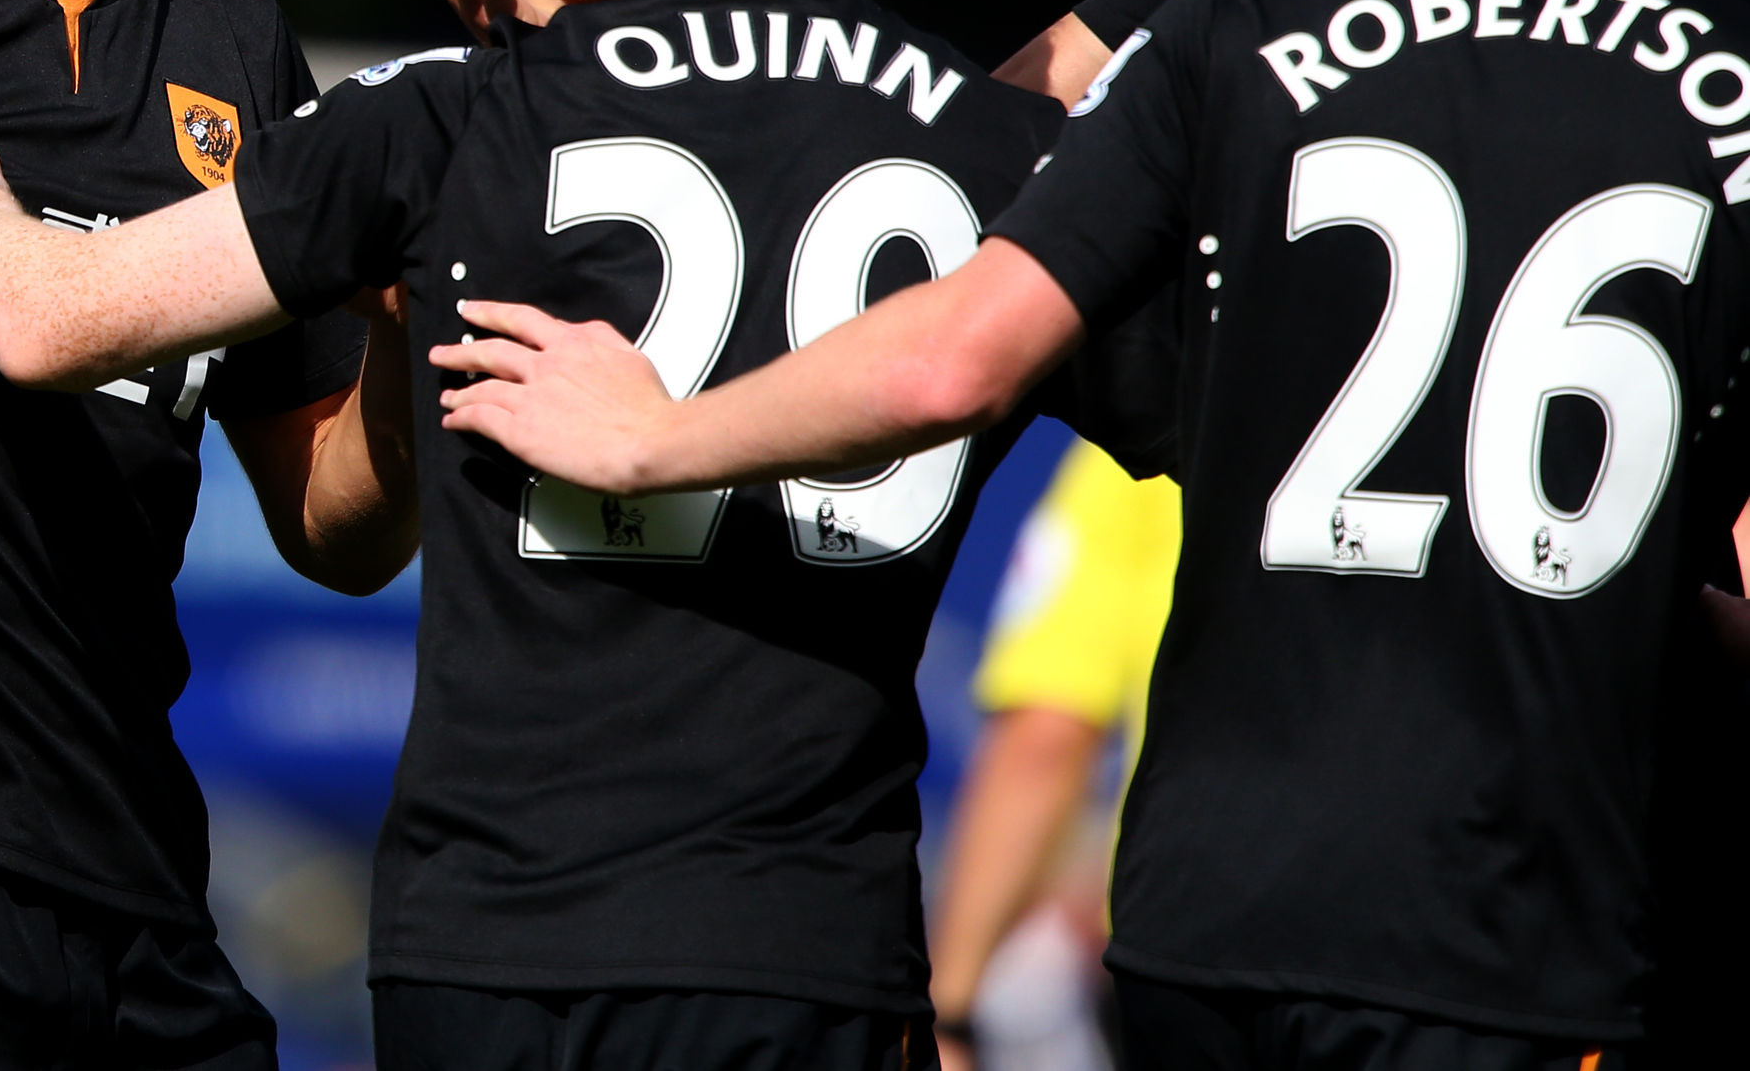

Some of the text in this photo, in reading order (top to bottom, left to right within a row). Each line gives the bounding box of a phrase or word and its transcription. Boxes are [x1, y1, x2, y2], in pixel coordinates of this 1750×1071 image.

[201, 166, 226, 183] 1904
[596, 10, 965, 125] QUINN
[518, 137, 983, 566] 29
[1260, 137, 1713, 599] 26
